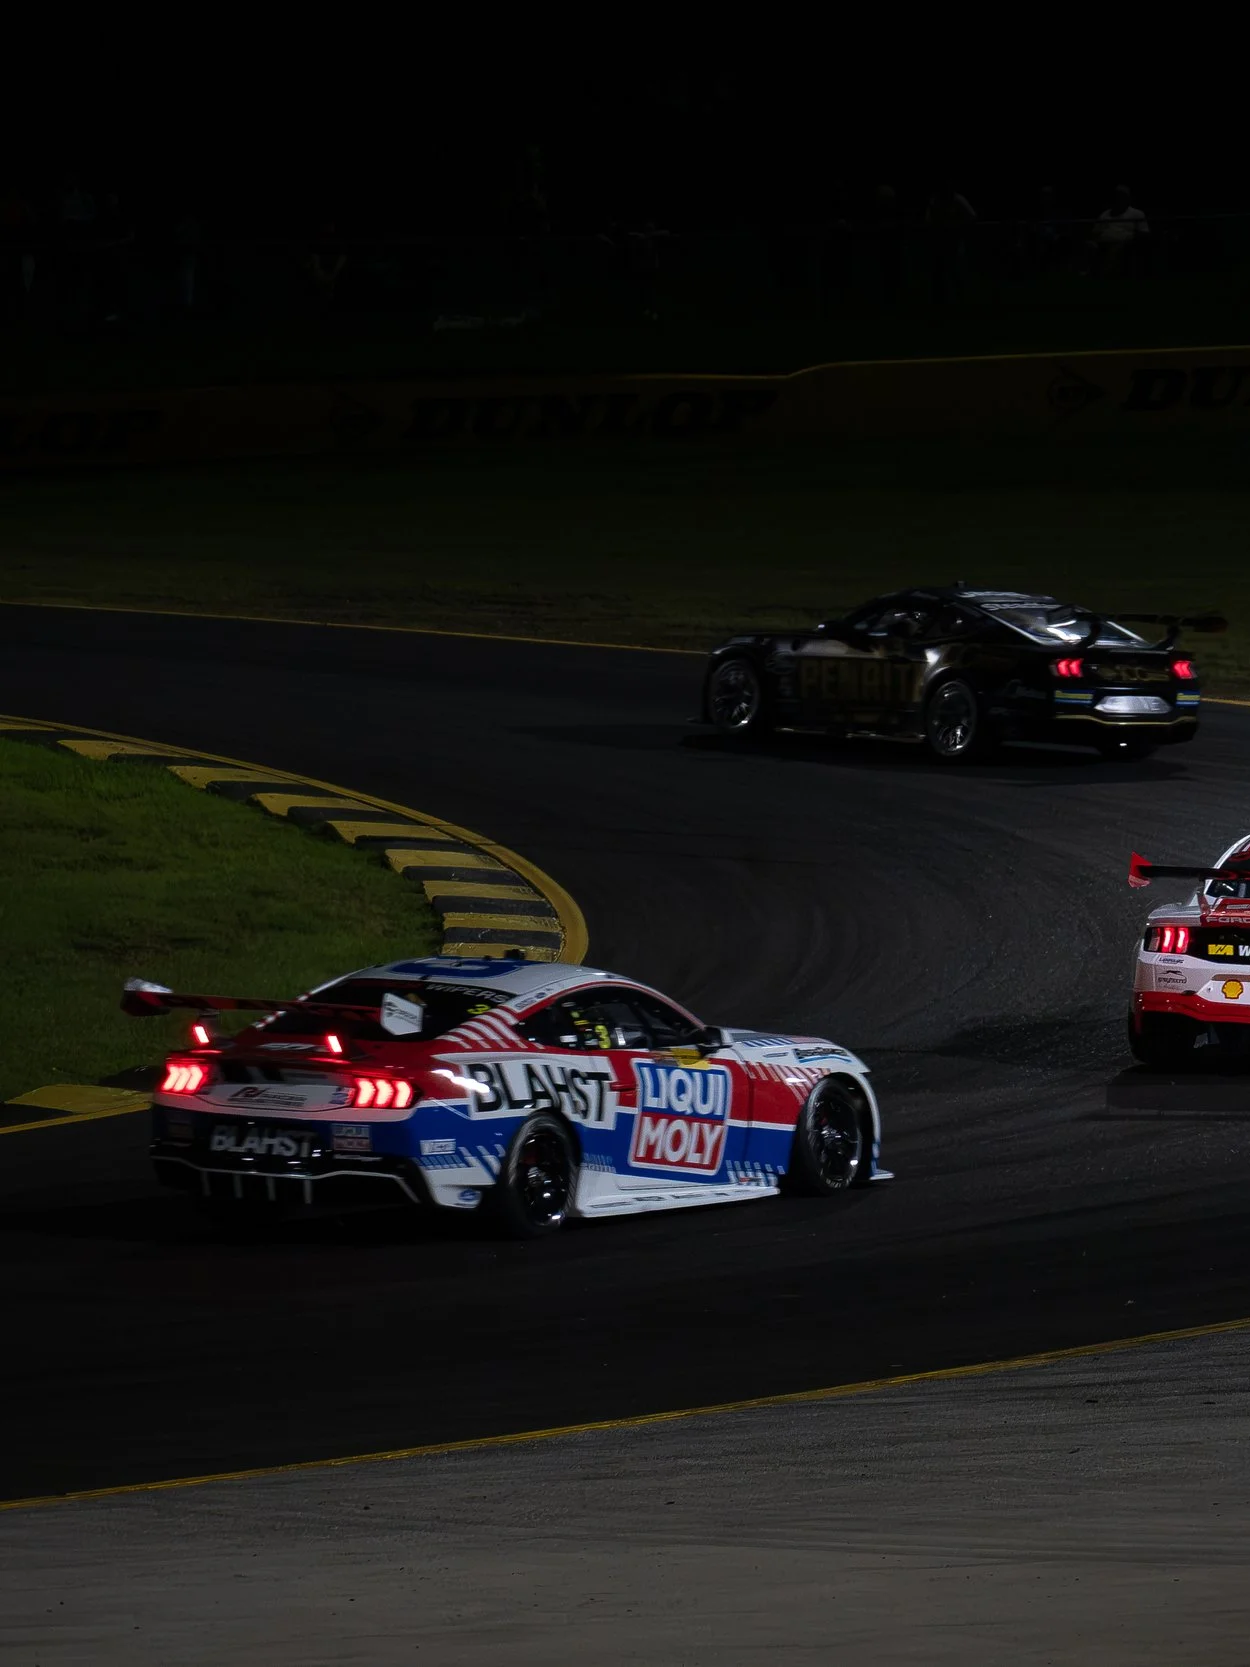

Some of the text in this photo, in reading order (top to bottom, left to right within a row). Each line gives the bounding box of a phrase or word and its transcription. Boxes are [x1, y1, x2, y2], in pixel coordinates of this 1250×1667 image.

[401, 389, 778, 441] DUNLOP
[425, 984, 513, 1004] WIPERS
[594, 1024, 612, 1049] 3
[466, 1062, 614, 1122] BLAHST
[639, 1066, 727, 1117] LIQUI
[209, 1124, 319, 1158] BLAHST
[635, 1117, 726, 1165] MOLY
